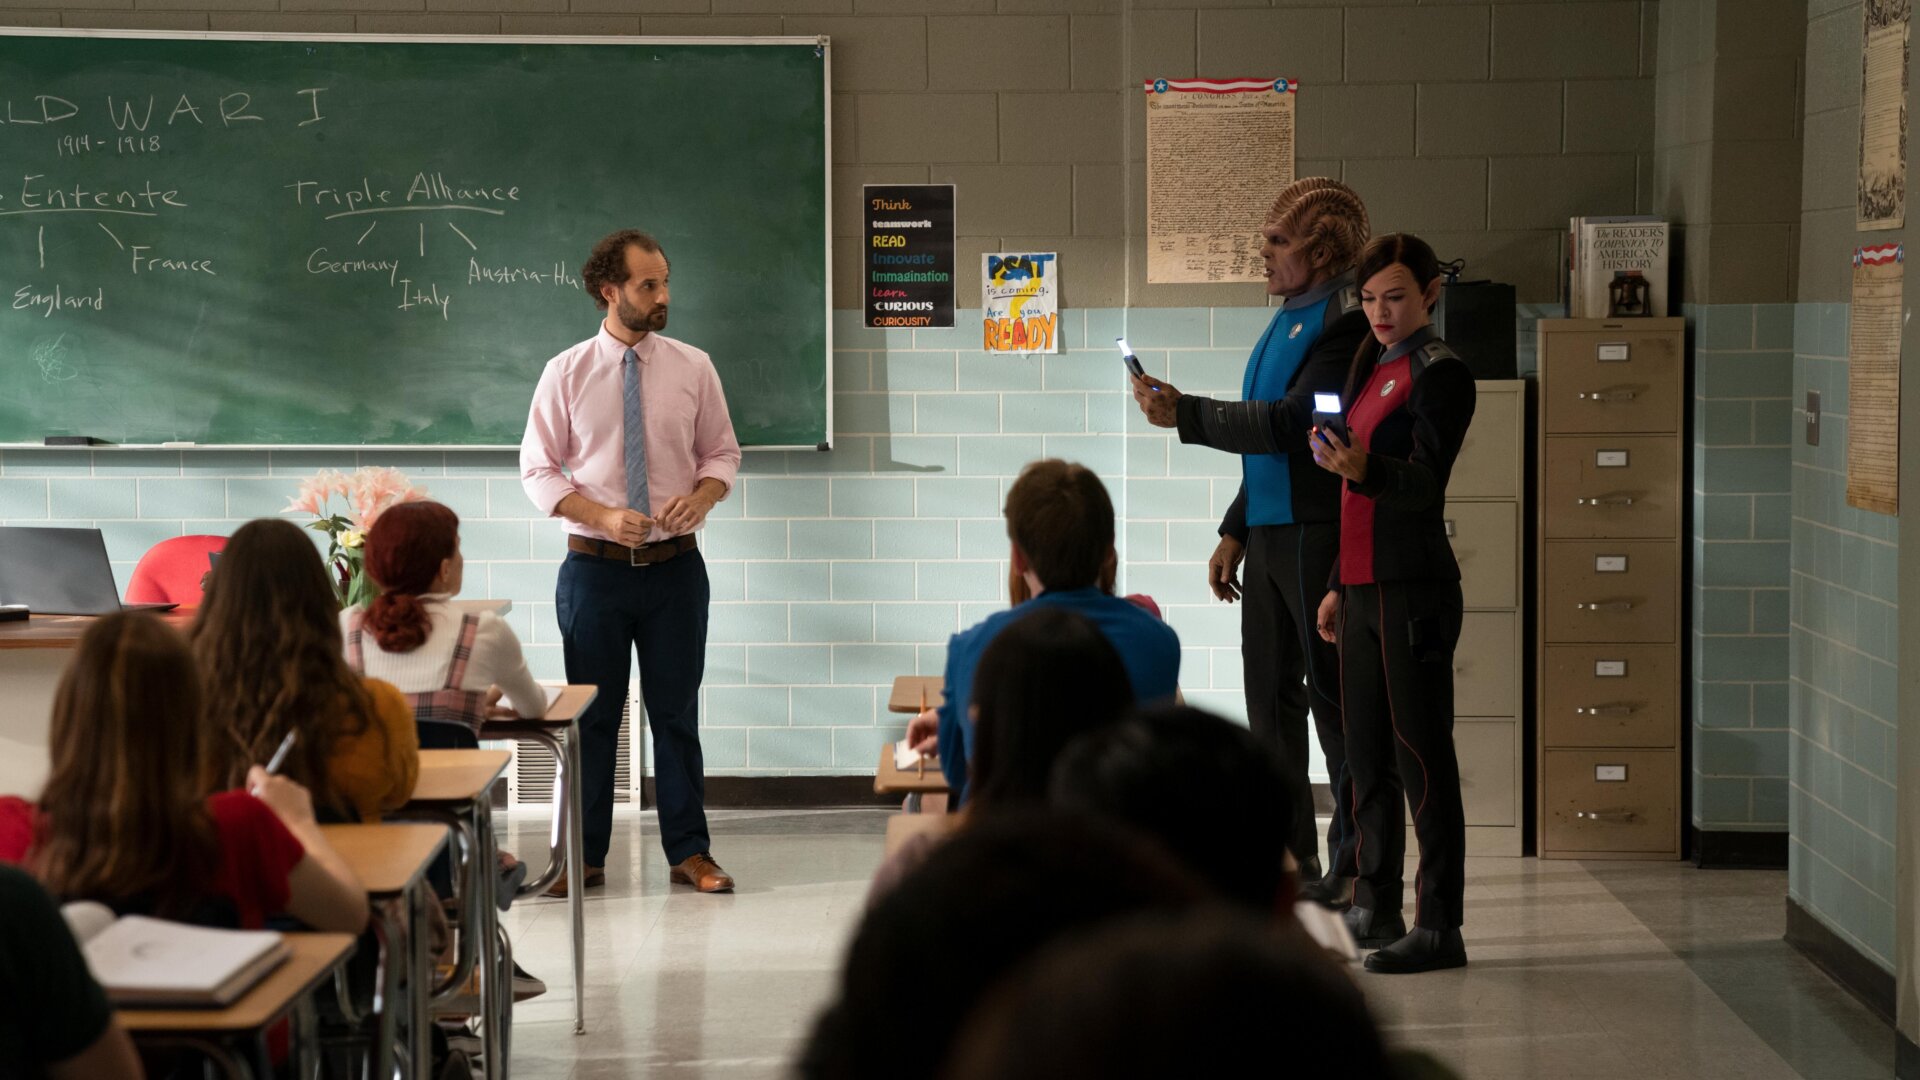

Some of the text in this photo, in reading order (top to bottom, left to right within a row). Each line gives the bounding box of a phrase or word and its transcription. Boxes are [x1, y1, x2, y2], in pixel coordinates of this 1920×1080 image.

[0, 95, 79, 124] LD
[297, 88, 329, 126] I
[57, 134, 90, 156] 1914
[118, 135, 160, 153] 1918
[22, 174, 188, 208] Entente
[284, 172, 520, 212] Triple Alliance
[872, 199, 912, 211] Think
[872, 220, 932, 228] teamwork
[1595, 229, 1610, 238] The
[872, 235, 906, 248] READ
[1593, 239, 1664, 249] COMPANION TO
[131, 245, 216, 275] France
[872, 253, 935, 265] Innovate
[1599, 249, 1659, 259] AMERICAN
[306, 247, 399, 288] Germany
[988, 254, 1055, 280] PSAT
[1602, 260, 1653, 269] HISTORY
[468, 256, 586, 290] Austria-Hu
[872, 271, 949, 282] Immagination
[986, 285, 996, 295] is
[12, 284, 103, 317] England
[397, 278, 449, 321] Italy
[873, 302, 934, 312] CURIOUS
[986, 306, 1042, 318] Are you
[873, 316, 932, 326] CURIOUSITY
[984, 312, 1057, 352] READY
